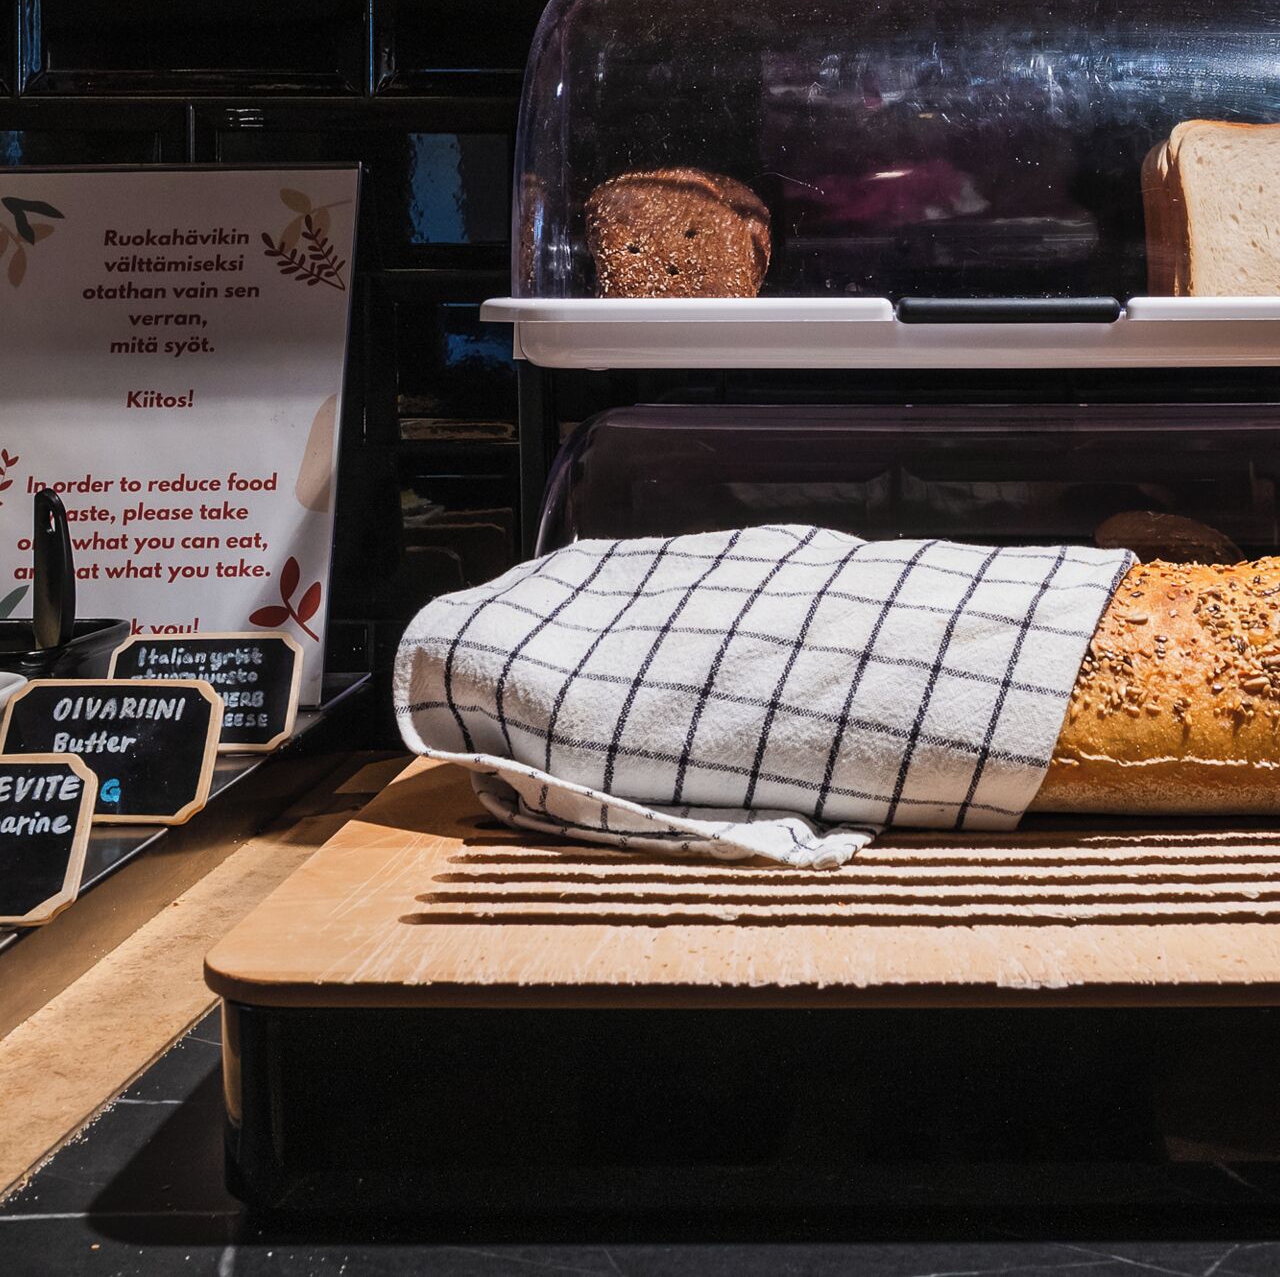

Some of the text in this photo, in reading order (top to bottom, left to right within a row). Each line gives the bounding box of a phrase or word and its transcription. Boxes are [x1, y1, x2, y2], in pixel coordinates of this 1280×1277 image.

[104, 228, 250, 247] Ruokahävikin
[104, 254, 245, 273] välttämiseksi
[82, 282, 261, 300] otathan vain sen
[128, 313, 208, 329] verran,
[110, 336, 216, 358] mitä syöt.
[126, 389, 194, 409] Kiitos!
[26, 472, 278, 494] In order to reduce food
[66, 501, 249, 525] aste, please take
[72, 532, 269, 554] what you can eat,
[76, 559, 272, 583] at what you take.
[53, 697, 186, 722] OIVARIINI
[221, 713, 268, 727] EESE
[52, 730, 137, 754] Butter
